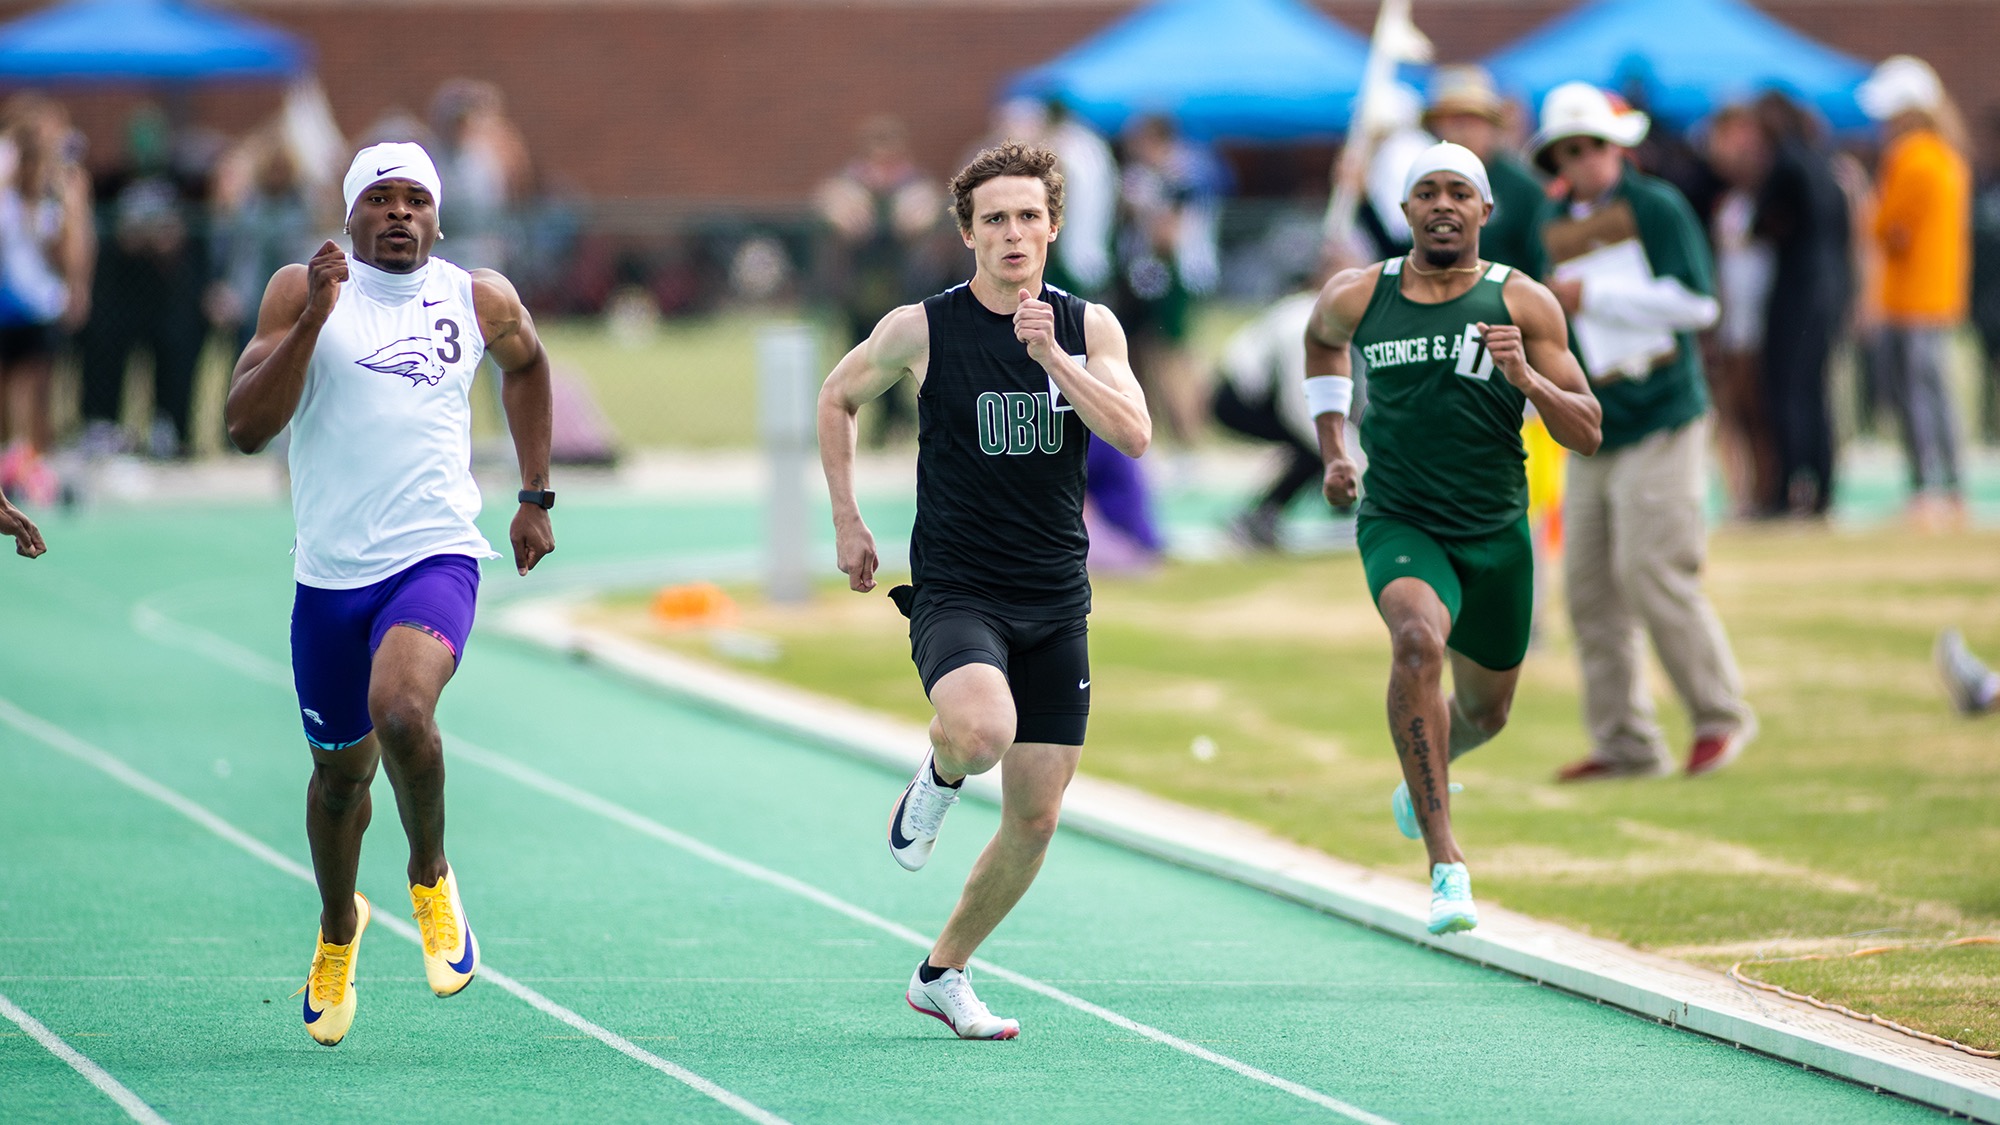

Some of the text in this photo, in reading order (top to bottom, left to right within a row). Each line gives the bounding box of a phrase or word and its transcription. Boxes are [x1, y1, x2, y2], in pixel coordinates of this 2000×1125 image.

[434, 318, 462, 364] 3
[1363, 337, 1428, 369] SCIENCE
[1432, 335, 1447, 360] &
[976, 391, 1065, 456] OBU
